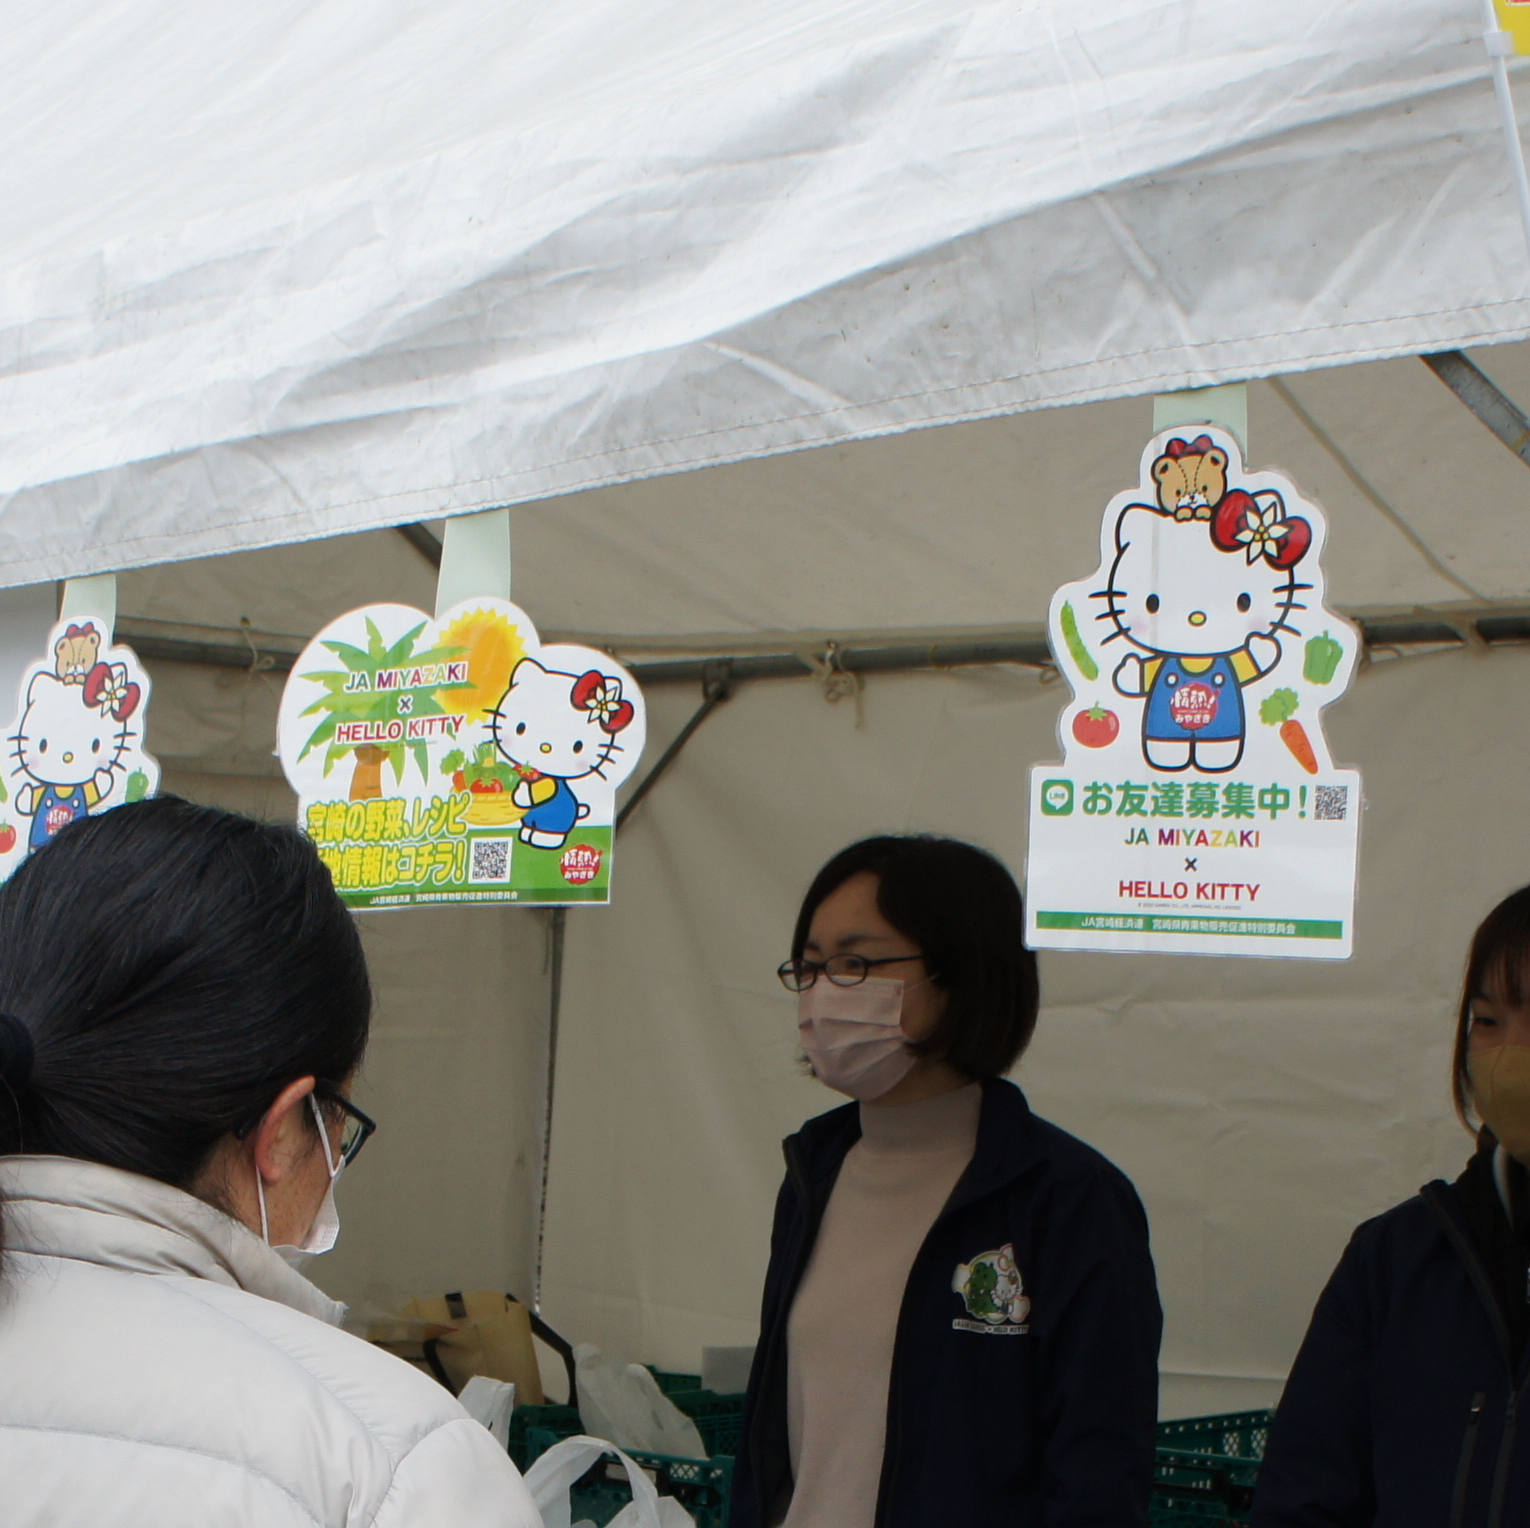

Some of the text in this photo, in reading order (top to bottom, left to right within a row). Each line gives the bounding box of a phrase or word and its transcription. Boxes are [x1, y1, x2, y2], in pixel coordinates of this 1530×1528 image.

[345, 663, 467, 691] JA MIYAZAKI
[336, 715, 466, 742] HELLO KITTY
[1081, 780, 1309, 820] お友達募集中!
[1124, 827, 1261, 848] JA MIYAZAKI
[318, 840, 465, 887] 地情報はコチラ!
[1118, 880, 1261, 902] HELLO KITTY
